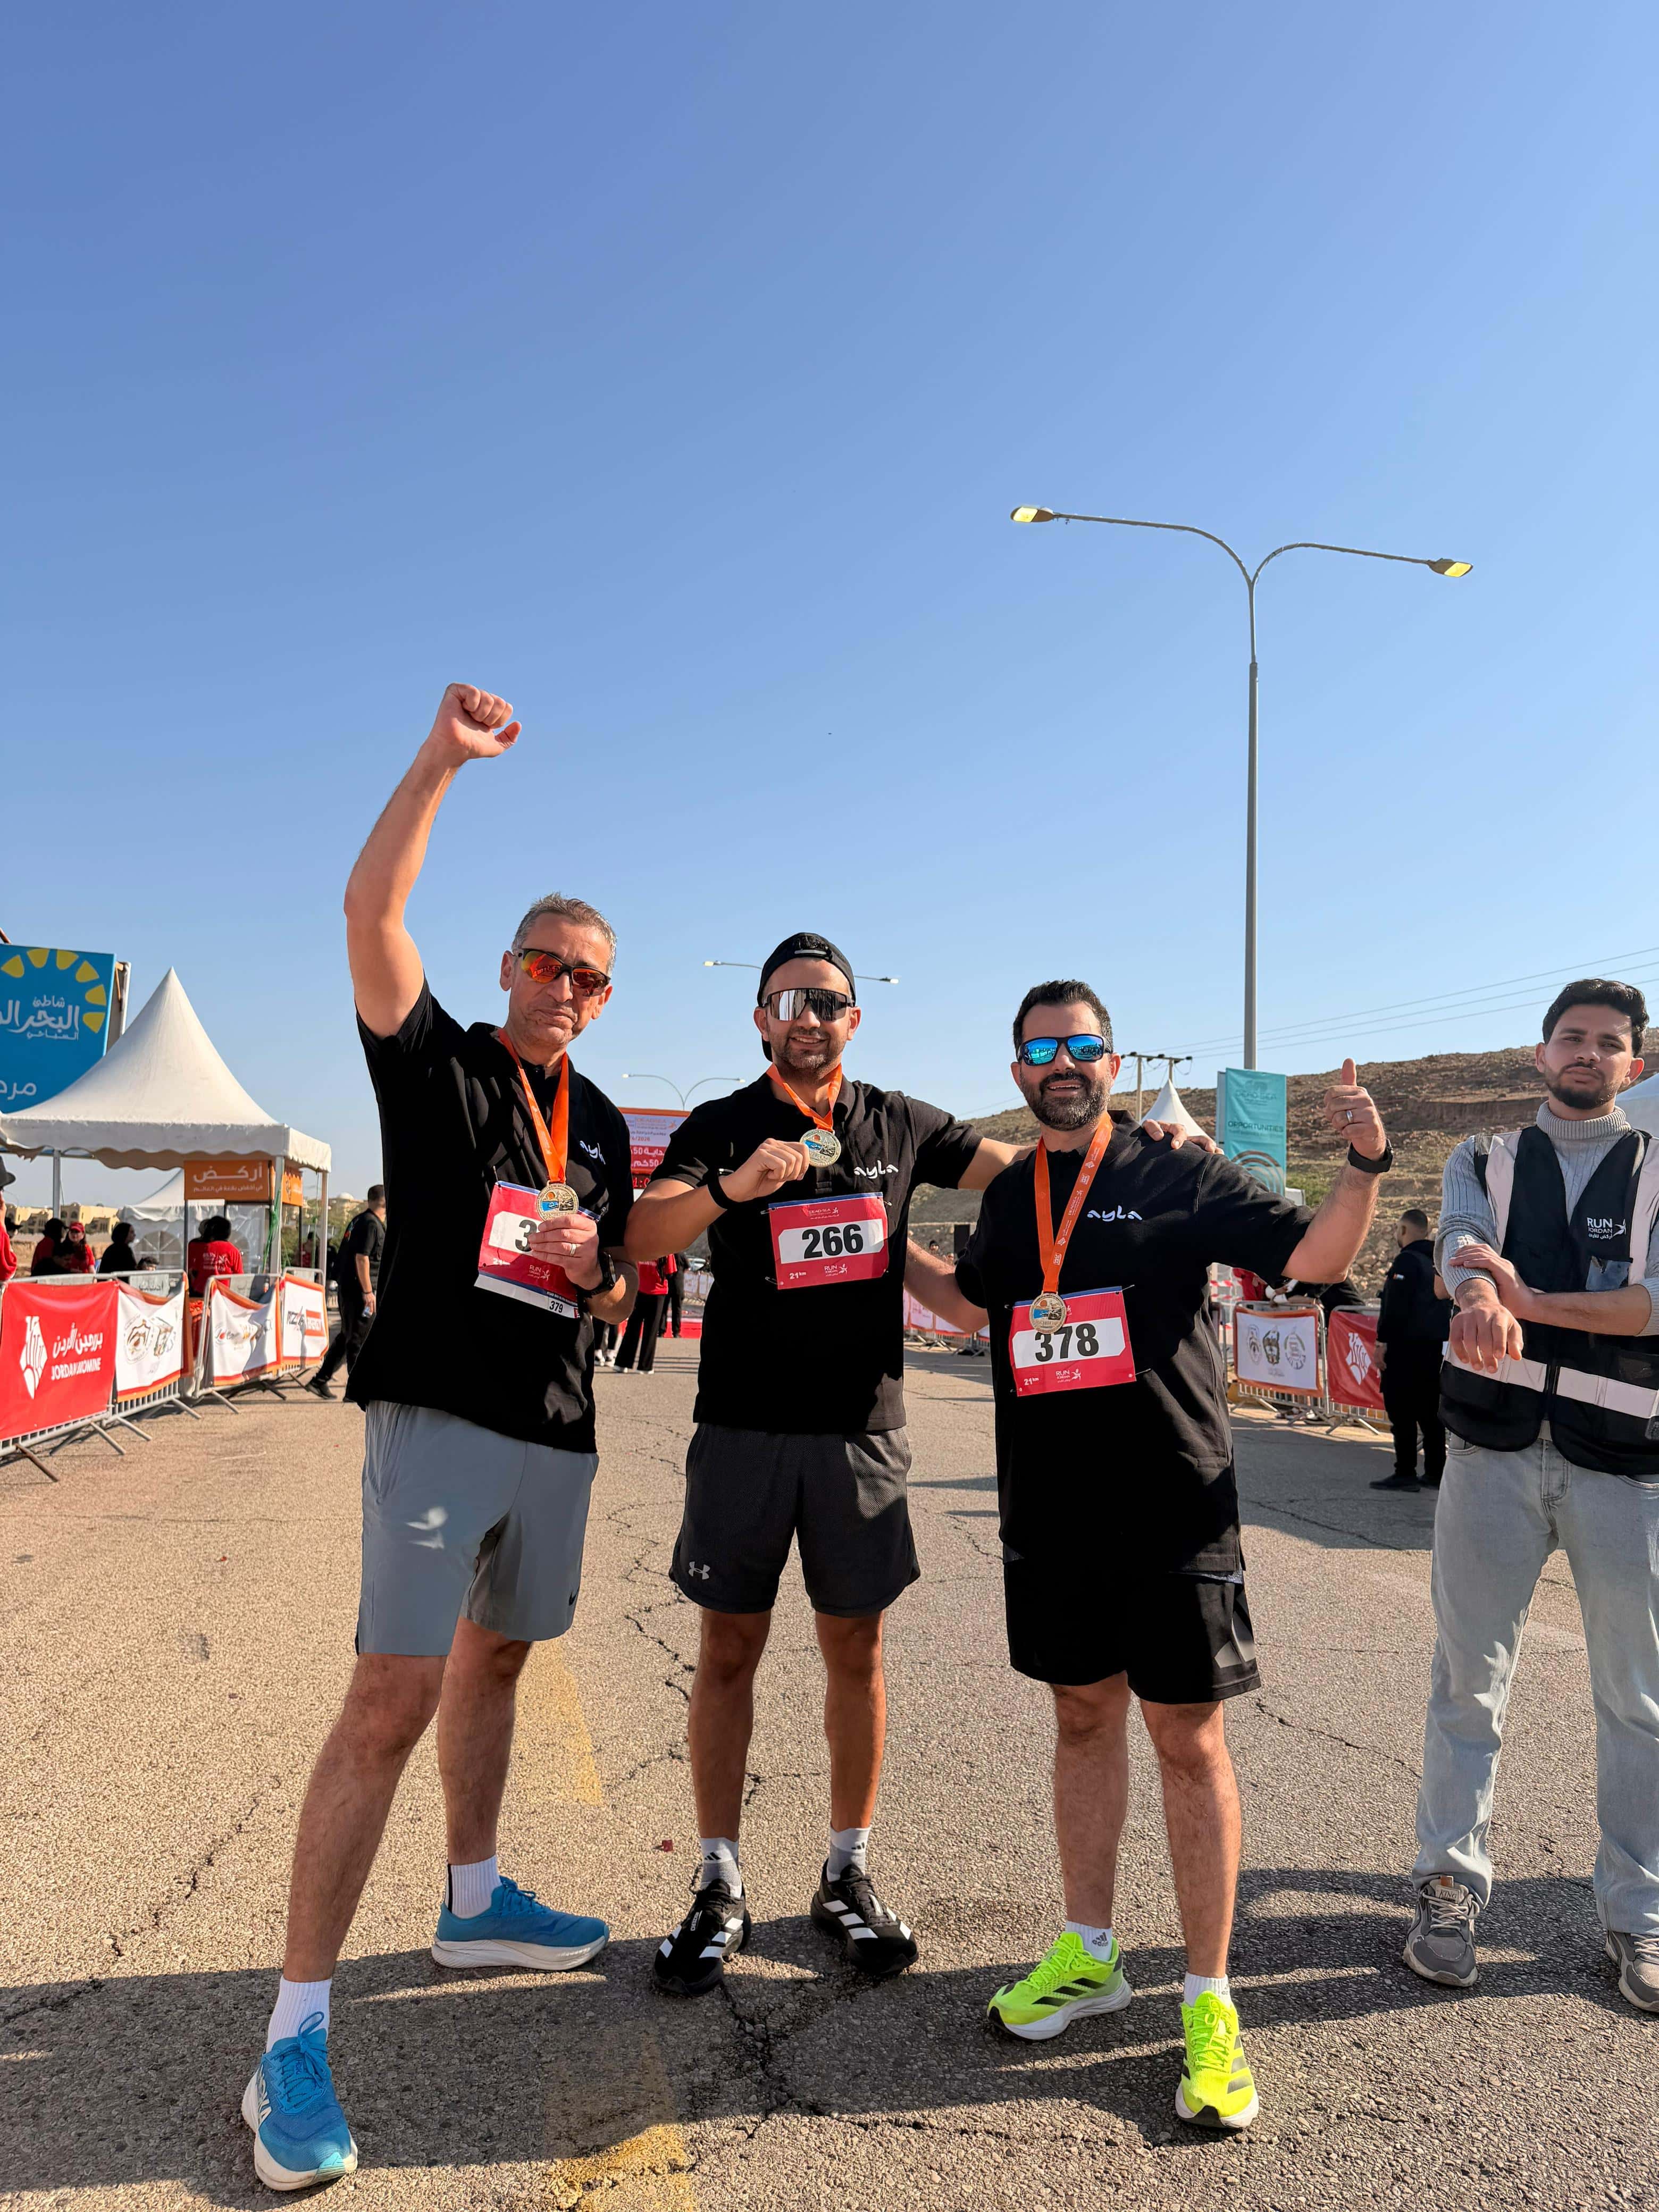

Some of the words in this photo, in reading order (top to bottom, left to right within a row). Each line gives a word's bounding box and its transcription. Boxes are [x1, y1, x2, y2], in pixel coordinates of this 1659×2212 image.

[32, 994, 65, 1008] شاطئ
[1228, 1121, 1284, 1132] OPPORTUNITIES
[853, 1160, 899, 1179] ayla
[1087, 1205, 1143, 1222] ayla
[1587, 1217, 1613, 1228] RUN
[801, 1224, 864, 1259] 266
[549, 1301, 563, 1313] 379
[1034, 1323, 1099, 1362] 378
